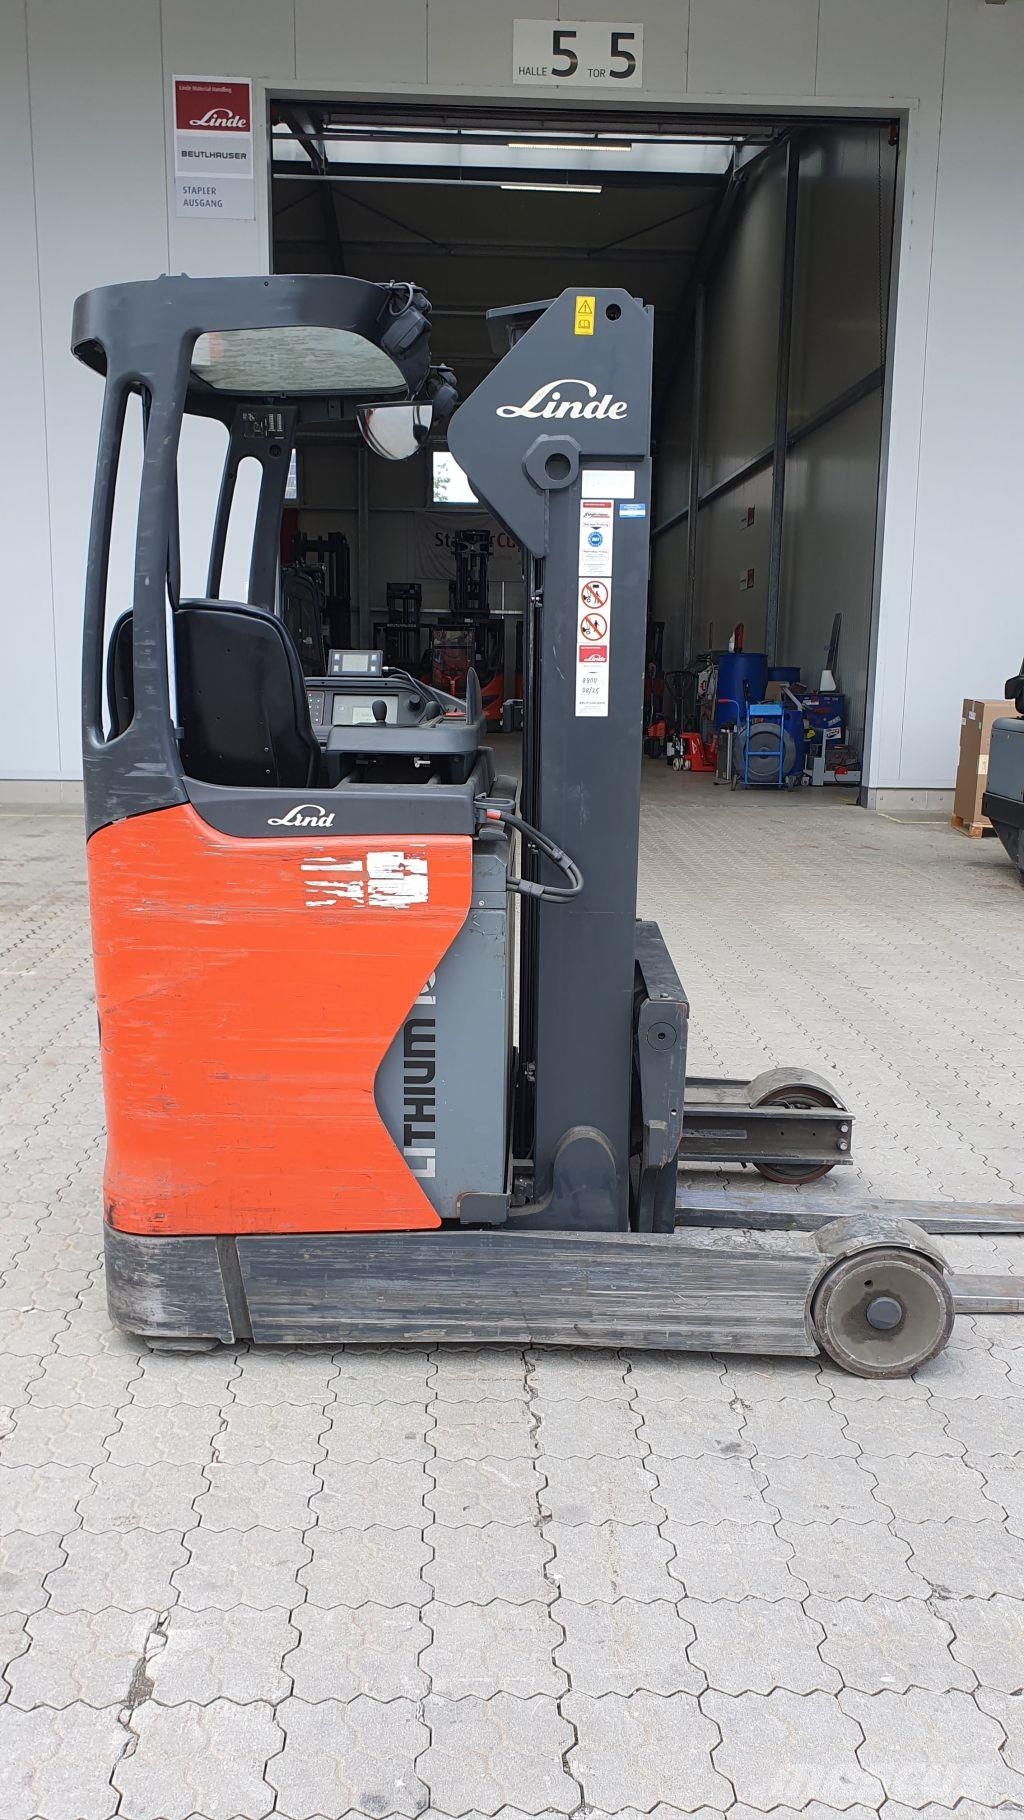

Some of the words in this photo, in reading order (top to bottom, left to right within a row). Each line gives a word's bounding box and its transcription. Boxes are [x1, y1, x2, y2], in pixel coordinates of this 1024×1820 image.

[518, 66, 547, 76] HALLE
[552, 30, 578, 77] 5
[587, 68, 606, 78] TOR
[609, 32, 636, 79] 5
[189, 108, 247, 128] Linde
[181, 150, 247, 160] BEUTLHAUSER
[182, 186, 217, 195] STAPLER
[183, 198, 223, 208] AUSGANG
[496, 379, 628, 419] Linde
[403, 1018, 436, 1179] LITHIUM
